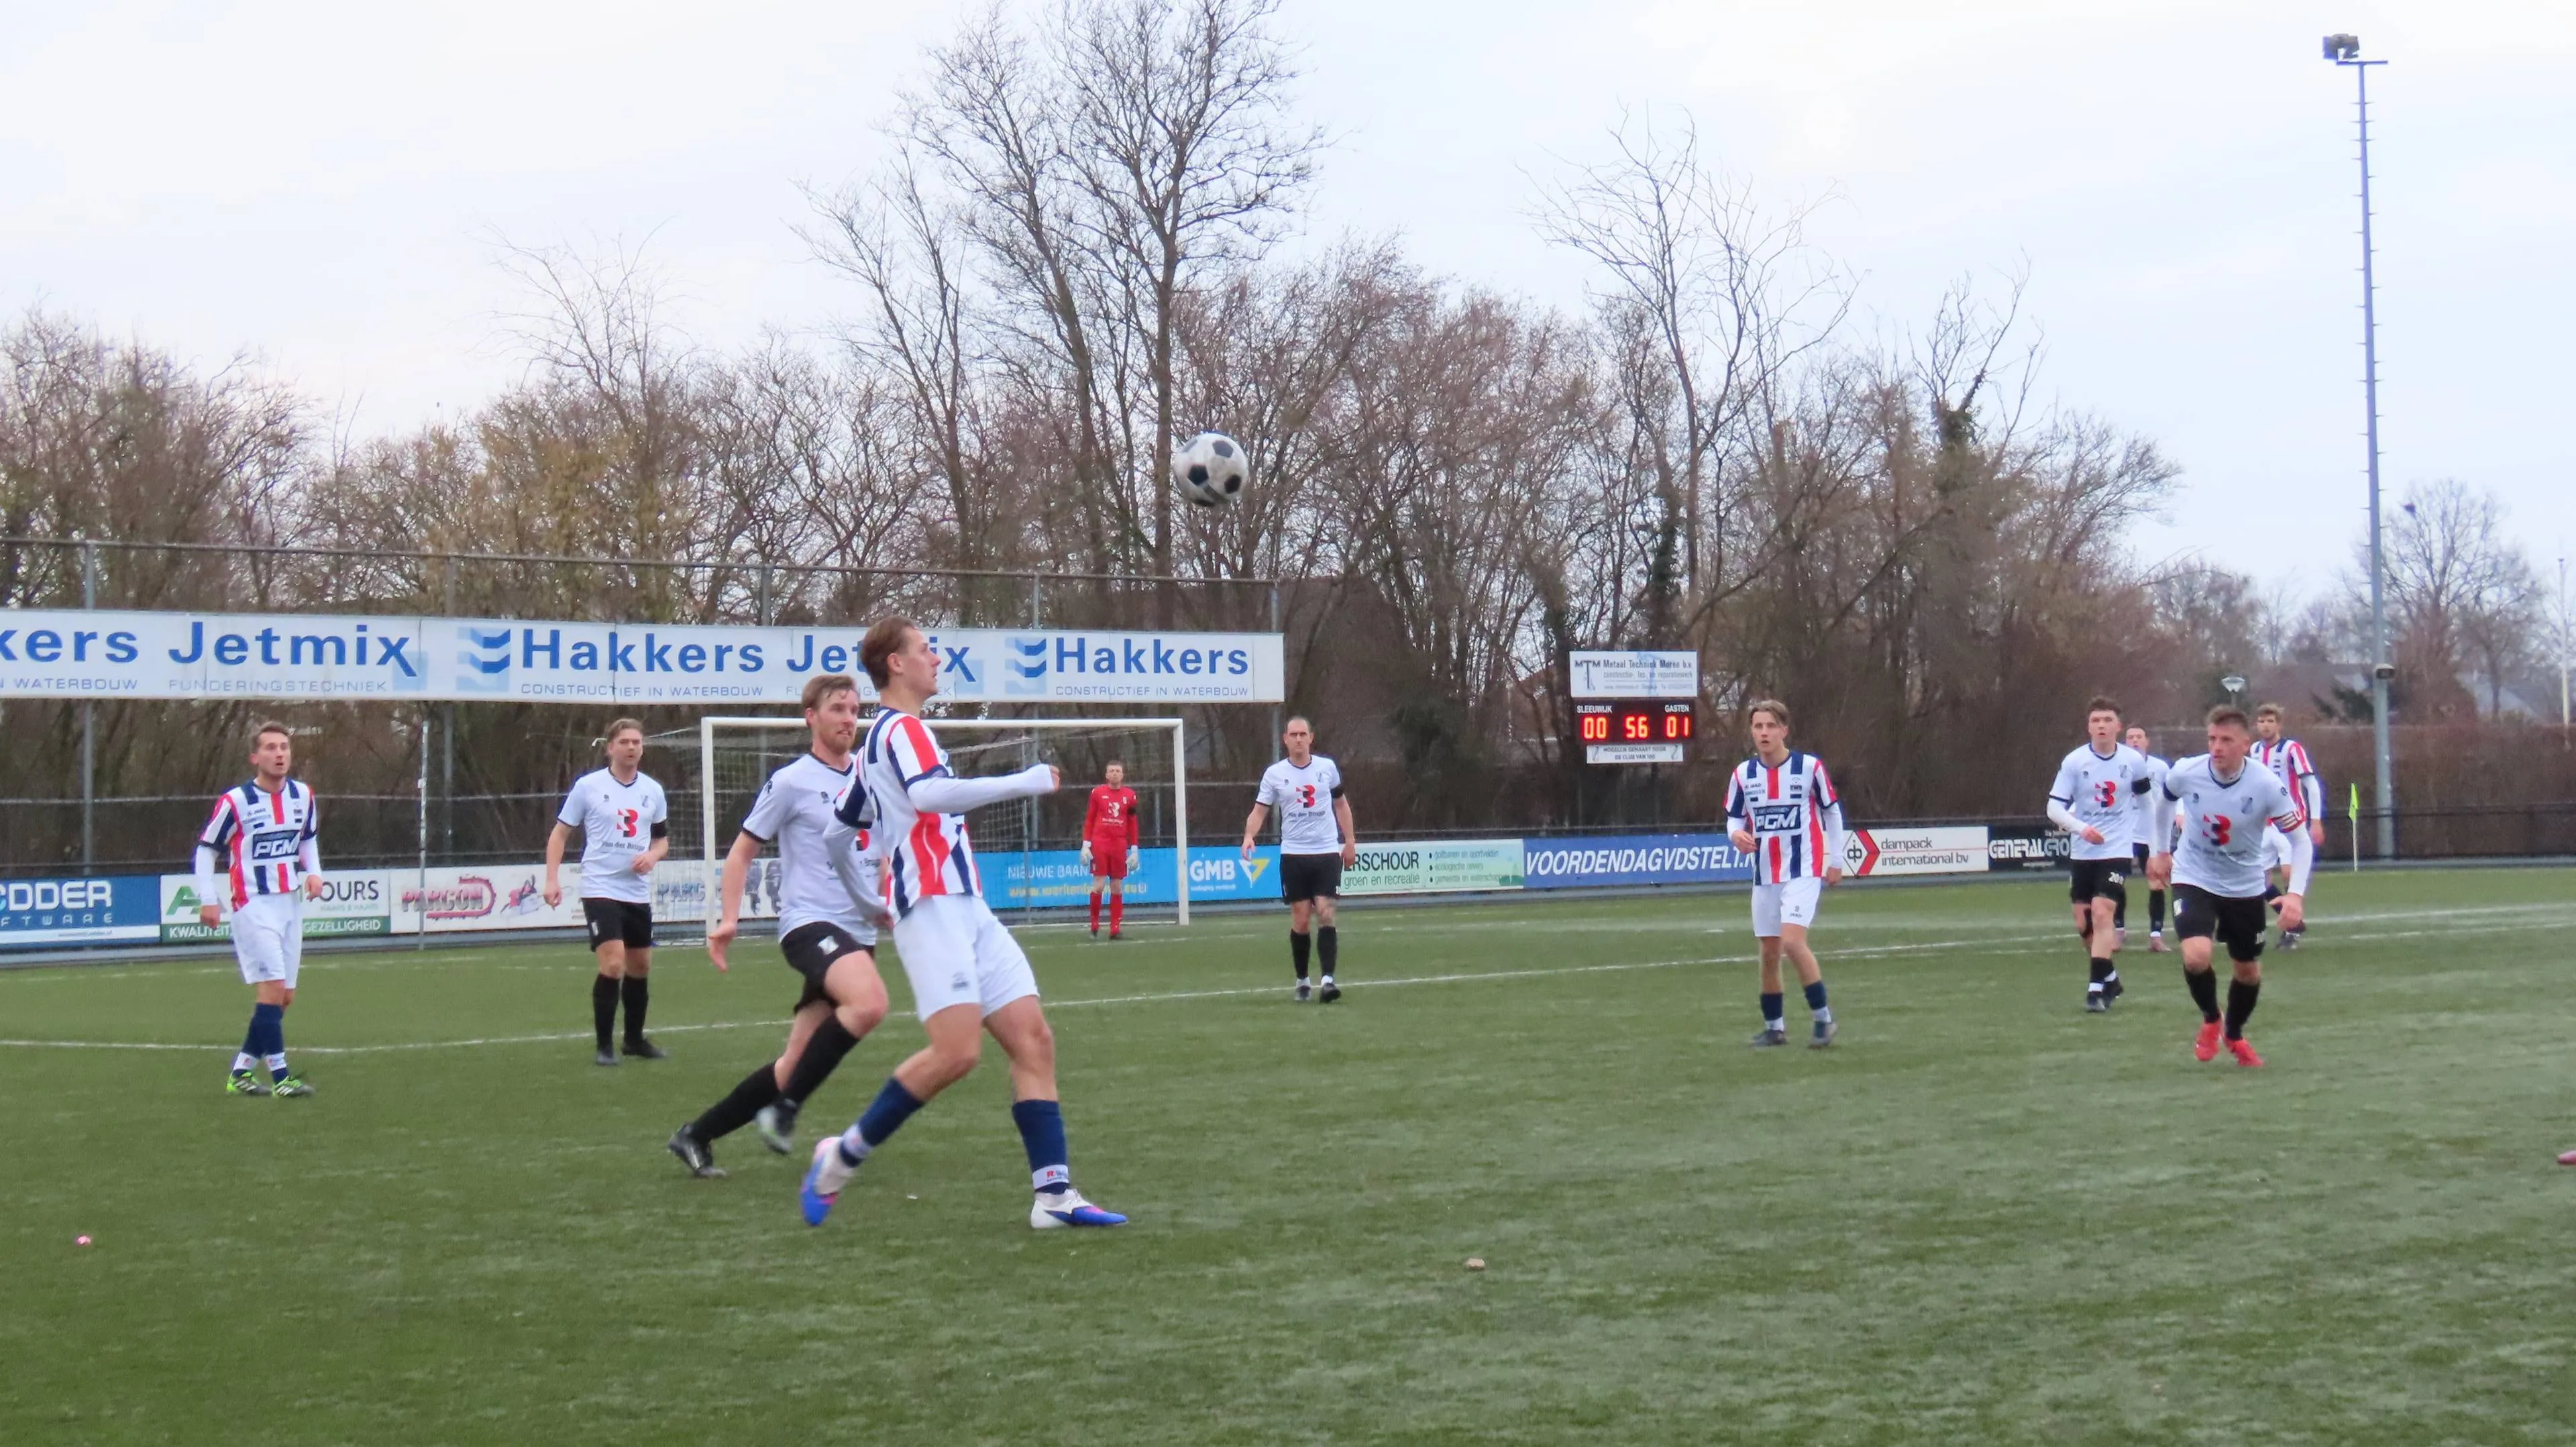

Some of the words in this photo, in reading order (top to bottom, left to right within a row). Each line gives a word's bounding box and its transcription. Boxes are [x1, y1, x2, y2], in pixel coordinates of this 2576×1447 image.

[168, 621, 417, 677] Jetmix
[523, 629, 764, 672] Hakkers
[786, 635, 977, 682] Jetx
[1057, 637, 1248, 675] Hakkers
[1603, 660, 1626, 669] Metaal
[1629, 659, 1657, 669] Techniek
[15, 678, 138, 690] WATERBOUW
[168, 680, 387, 692] FUNDERINGSTECHNIEK
[521, 684, 641, 696] CONSTRUCTIEF
[649, 687, 662, 696] IN
[671, 686, 763, 696] WATERBOUW
[1056, 686, 1150, 696] CONSTRUCTIEF
[1156, 687, 1167, 696] IN
[1173, 686, 1248, 696] WATERBOUW
[1576, 705, 1613, 714] SLEEUWIJK
[1664, 704, 1690, 713] GASTEN
[1584, 716, 1608, 739] 00
[1625, 716, 1648, 739] 56
[1881, 837, 1933, 851] dampack
[1988, 837, 2045, 859] GENERAL
[1881, 852, 1953, 867] international
[1955, 852, 1969, 863] bv
[1008, 865, 1054, 879] NIEUWE
[1189, 859, 1236, 882] GMB
[1344, 876, 1367, 889] groen
[1371, 875, 1382, 886] en
[1385, 873, 1420, 885] recreatie
[0, 880, 113, 911] DDER
[303, 919, 381, 934] GEZELLIGHEID
